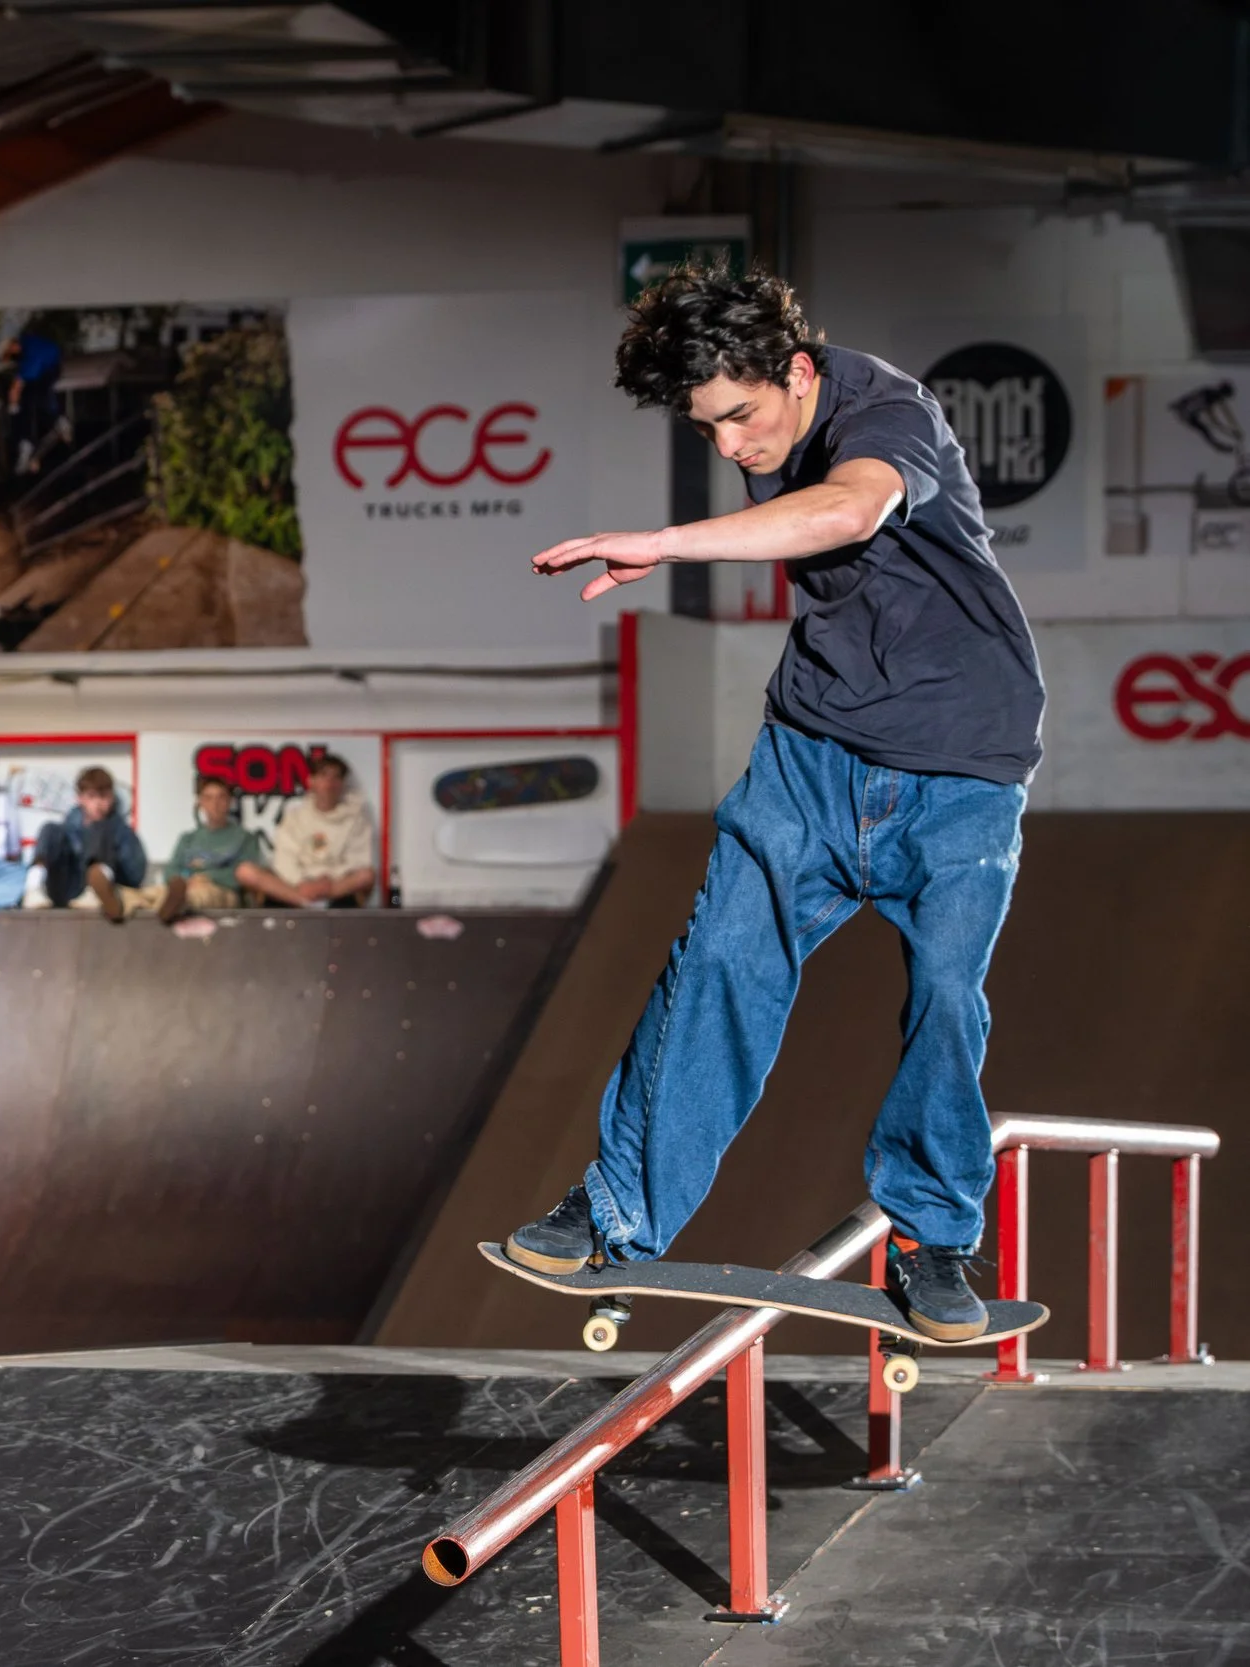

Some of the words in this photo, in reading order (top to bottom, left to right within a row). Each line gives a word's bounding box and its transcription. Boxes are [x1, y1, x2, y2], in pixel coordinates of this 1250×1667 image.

[333, 403, 553, 490] ACE
[365, 502, 461, 519] TRUCKS
[470, 500, 523, 517] MFG
[195, 744, 328, 794] SON
